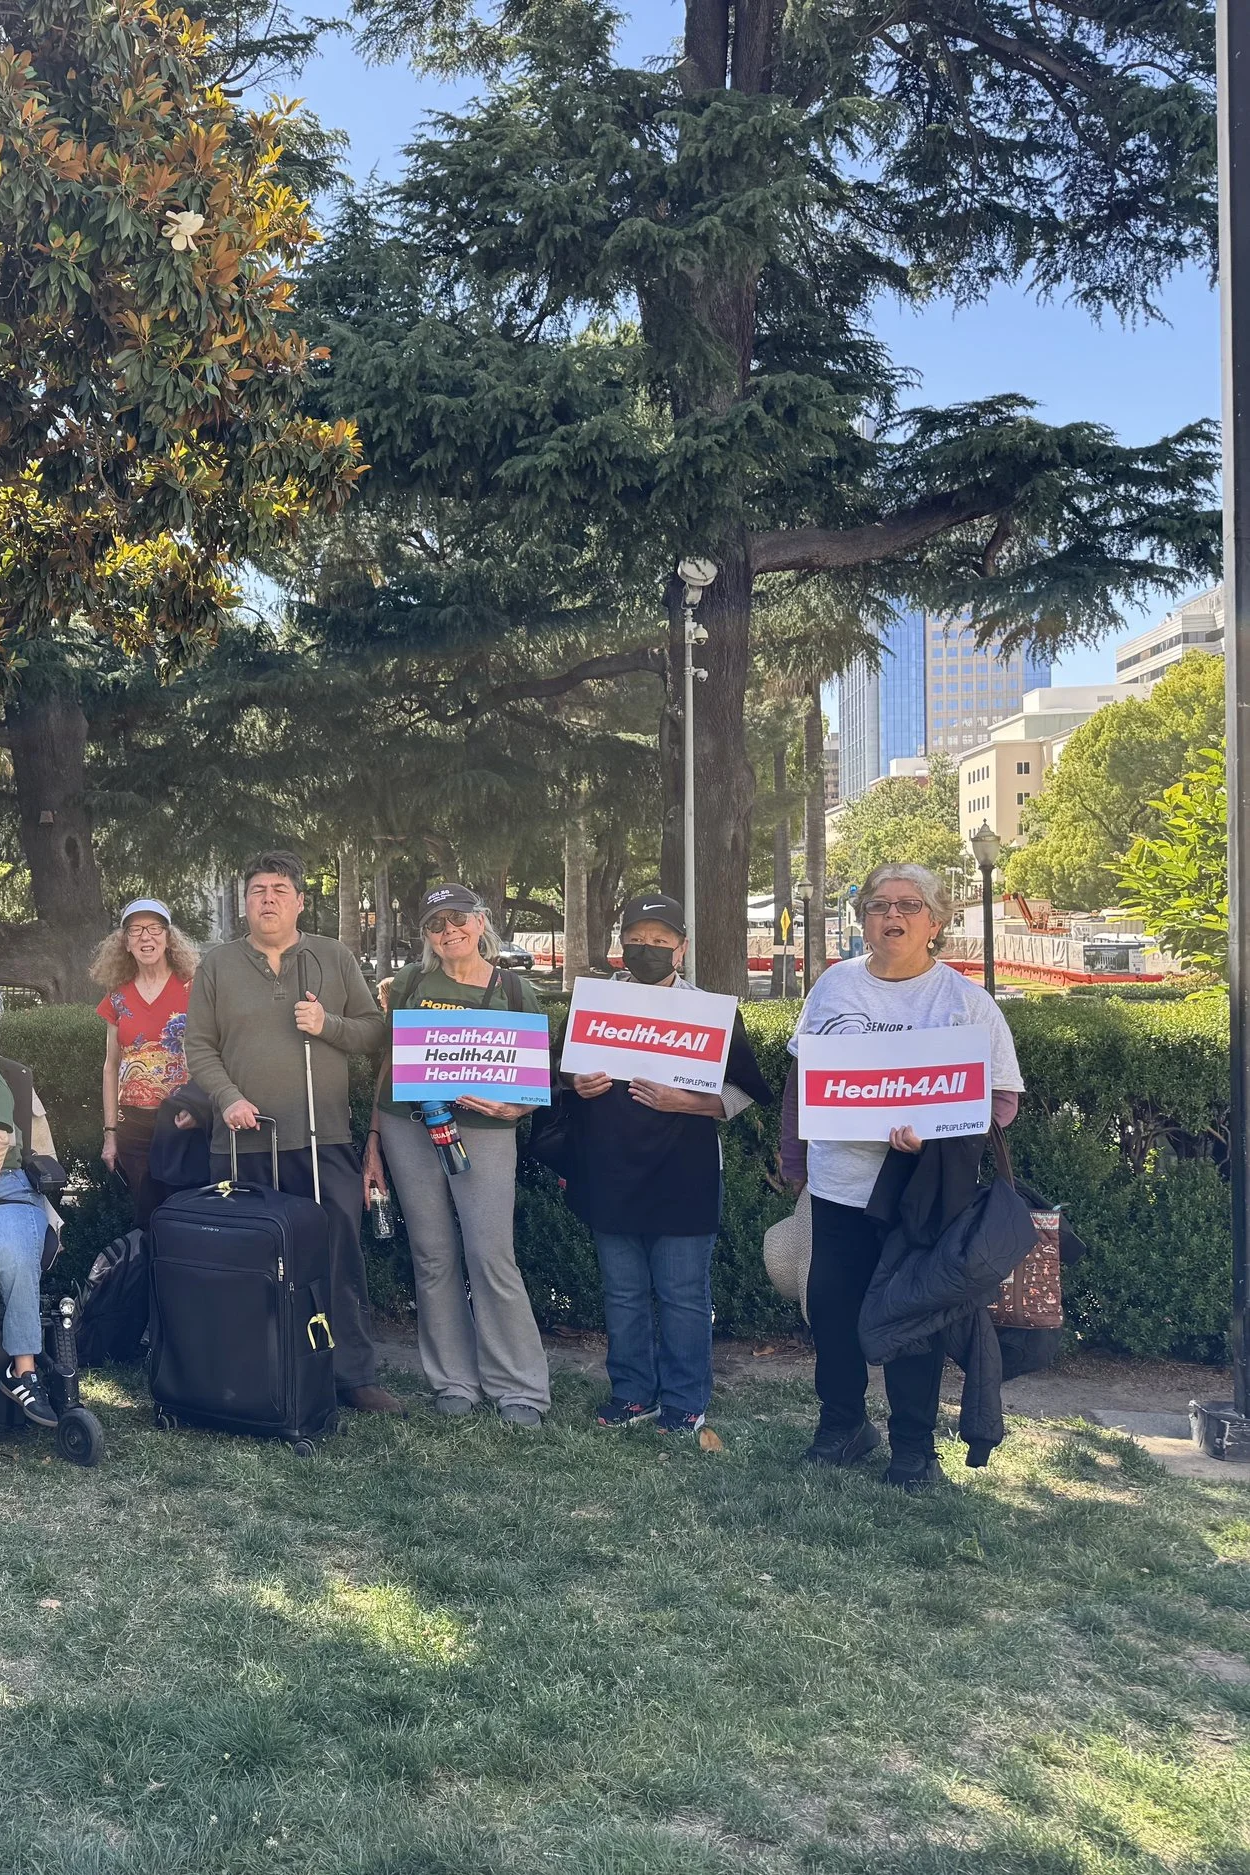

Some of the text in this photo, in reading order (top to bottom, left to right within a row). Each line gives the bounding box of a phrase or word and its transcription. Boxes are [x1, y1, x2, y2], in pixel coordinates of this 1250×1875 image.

[865, 1022, 904, 1032] SENIOR
[424, 1029, 517, 1045] Health4All
[586, 1019, 711, 1052] Health4All
[424, 1048, 517, 1063] Health4All
[424, 1066, 518, 1083] Health4All
[824, 1071, 967, 1099] Health4All
